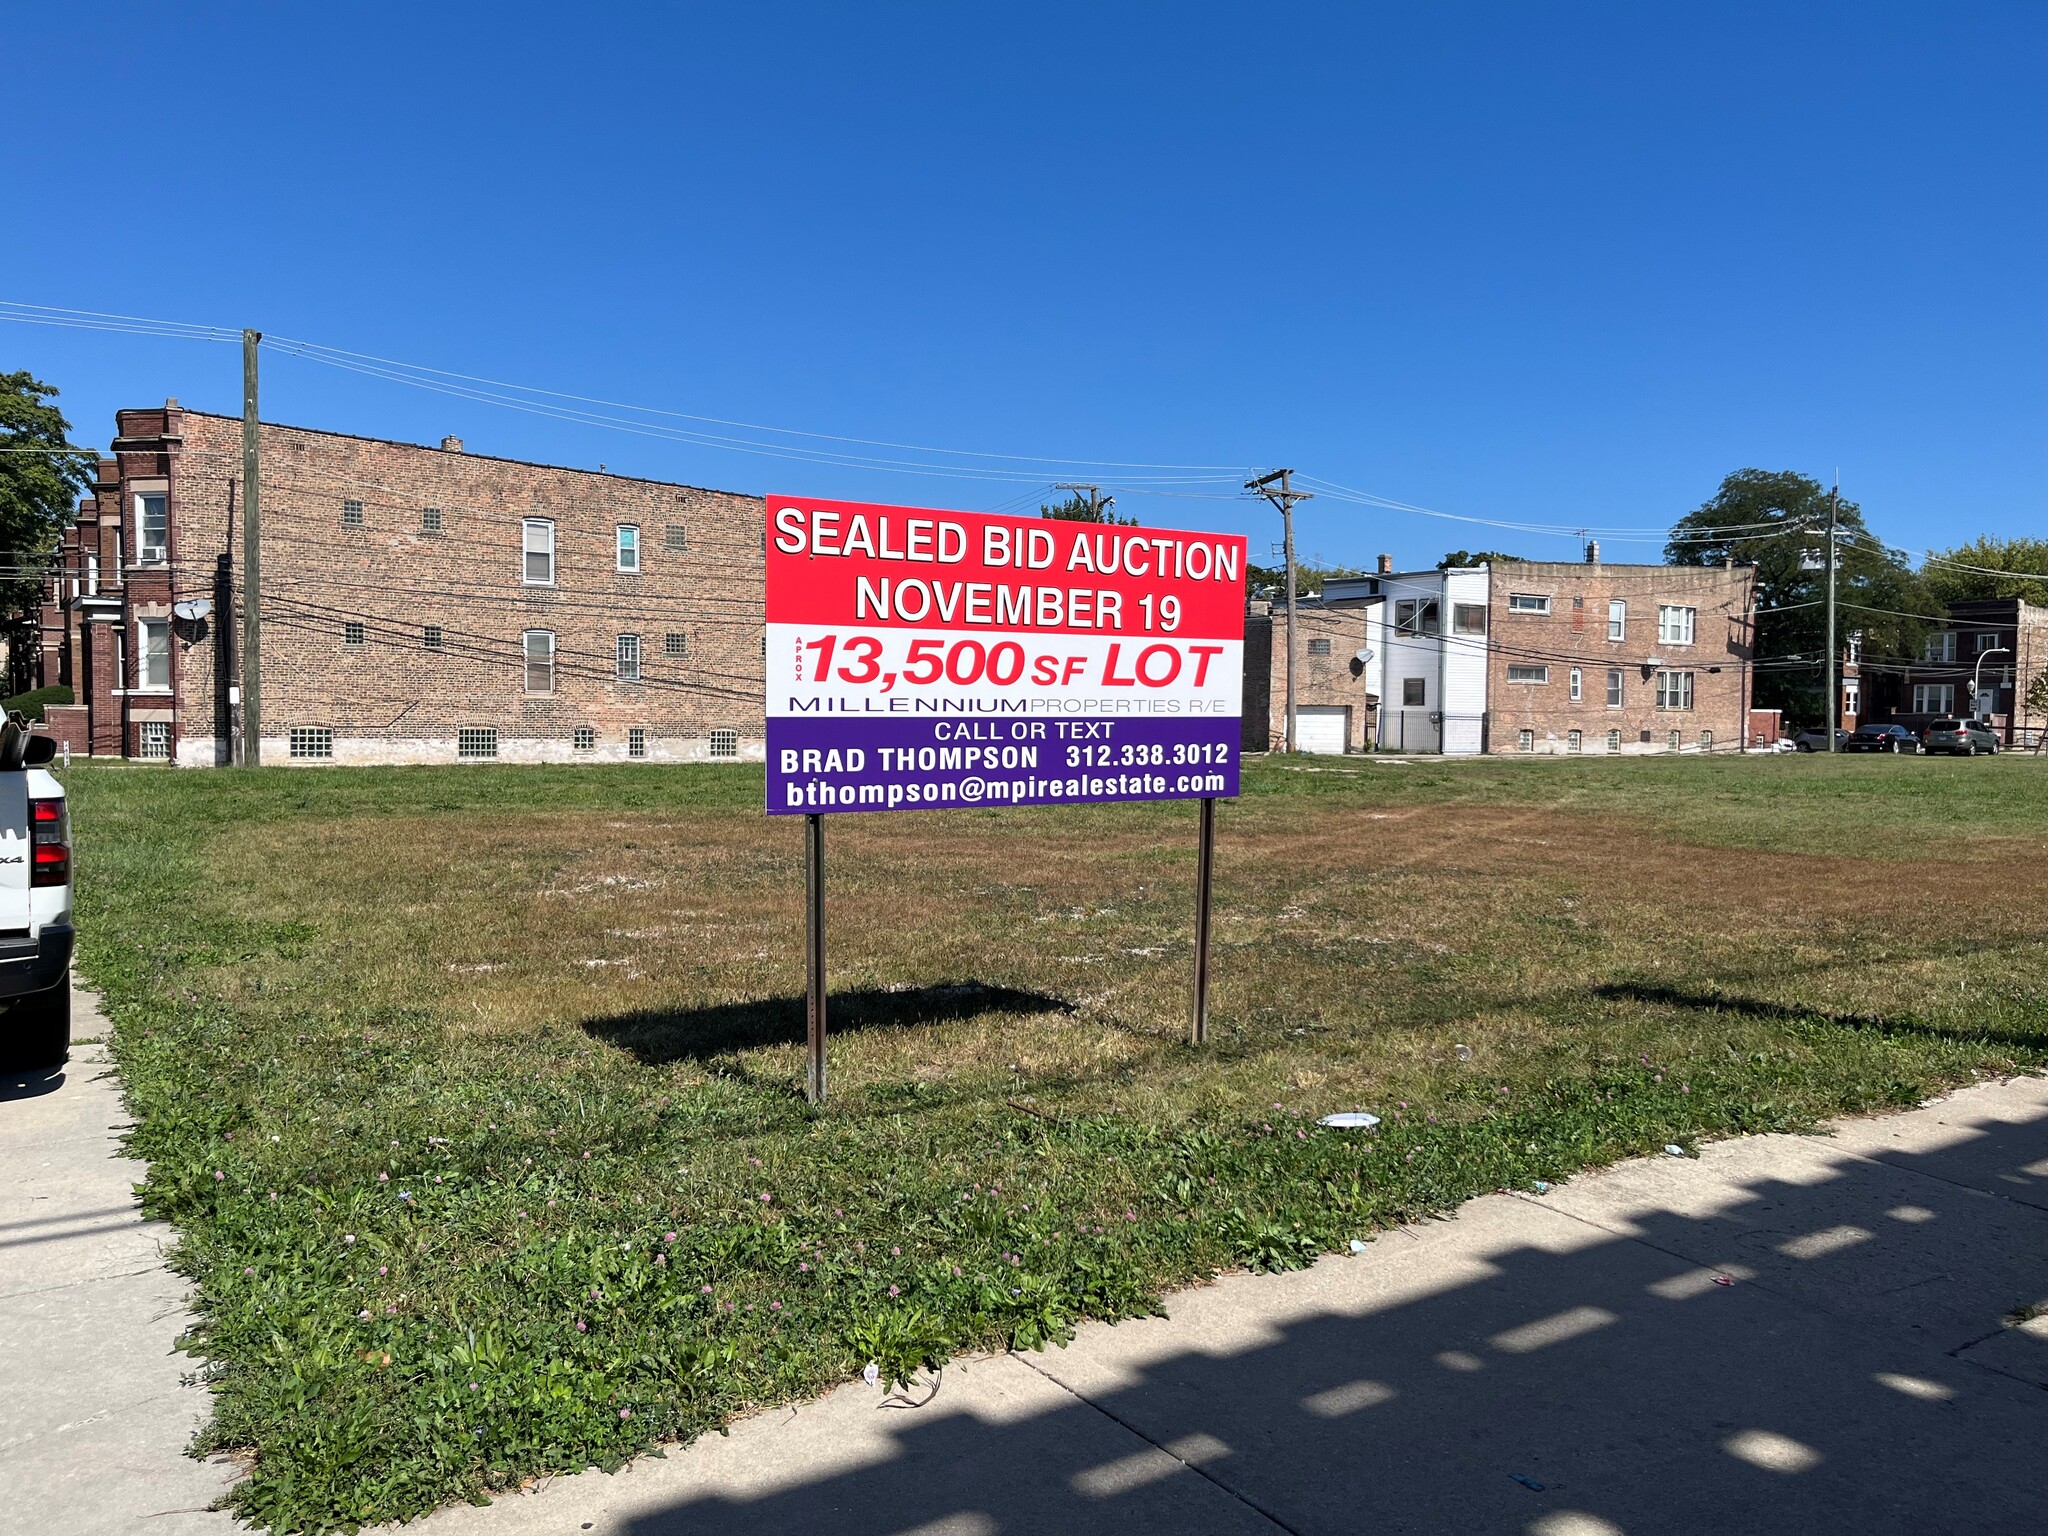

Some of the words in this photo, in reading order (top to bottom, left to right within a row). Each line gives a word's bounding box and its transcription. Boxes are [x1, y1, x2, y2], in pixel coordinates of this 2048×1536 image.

[774, 507, 967, 564] SEALED
[983, 525, 1055, 570] BID
[1066, 532, 1238, 582] AUCTION
[856, 576, 1122, 630] NOVEMBER
[1138, 594, 1181, 632] 19
[795, 636, 803, 682] APROX
[805, 634, 1026, 694] 13,500
[1031, 655, 1088, 686] SF
[1101, 643, 1224, 688] LOT
[1189, 699, 1226, 713] R/E
[934, 722, 1004, 741] CALL
[1011, 722, 1046, 740] OR
[1055, 721, 1115, 739] TEXT
[780, 748, 865, 774] BRAD
[877, 745, 1037, 772] THOMPSON
[1066, 743, 1228, 768] 312.338.3012
[786, 772, 1225, 808] bthompson@mpirealestate.com
